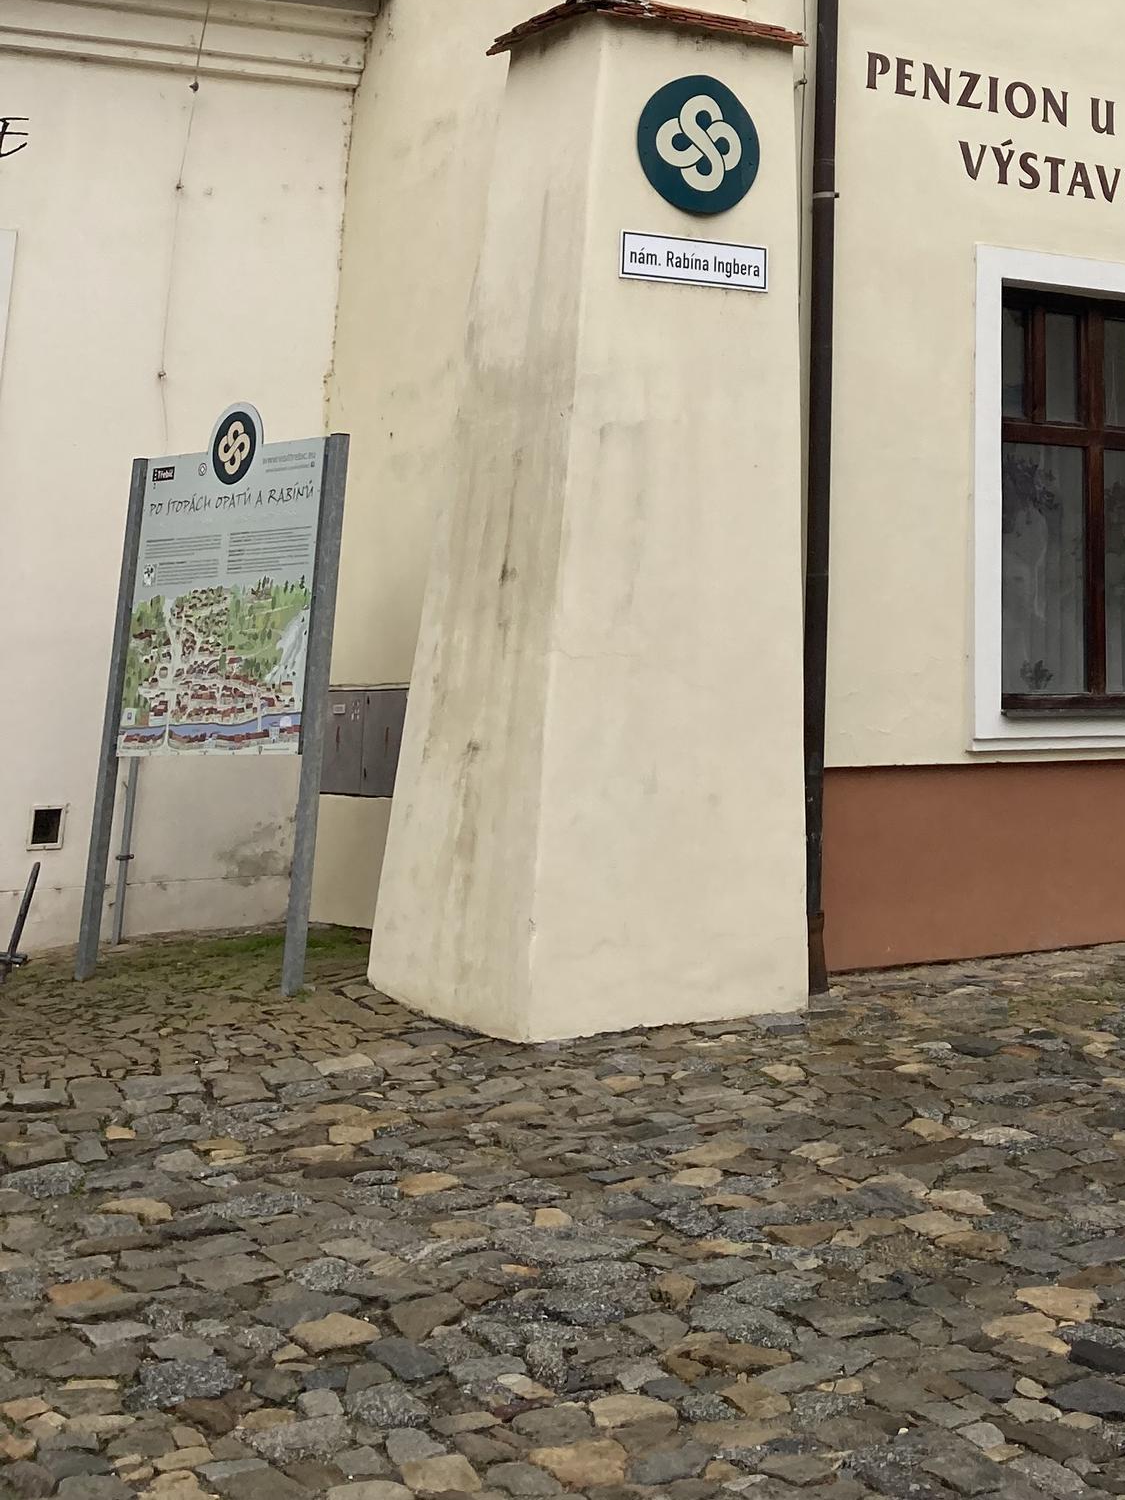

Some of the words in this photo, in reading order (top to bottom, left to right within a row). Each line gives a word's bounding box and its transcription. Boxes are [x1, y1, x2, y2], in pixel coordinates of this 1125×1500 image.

[865, 51, 1069, 128] PENZION
[1090, 97, 1116, 136] U
[629, 247, 662, 267] nám.
[666, 250, 709, 272] Rabína
[713, 255, 760, 278] Ingbera
[149, 502, 163, 516] PO
[165, 492, 212, 516] STOPÁCH
[254, 490, 263, 508] A
